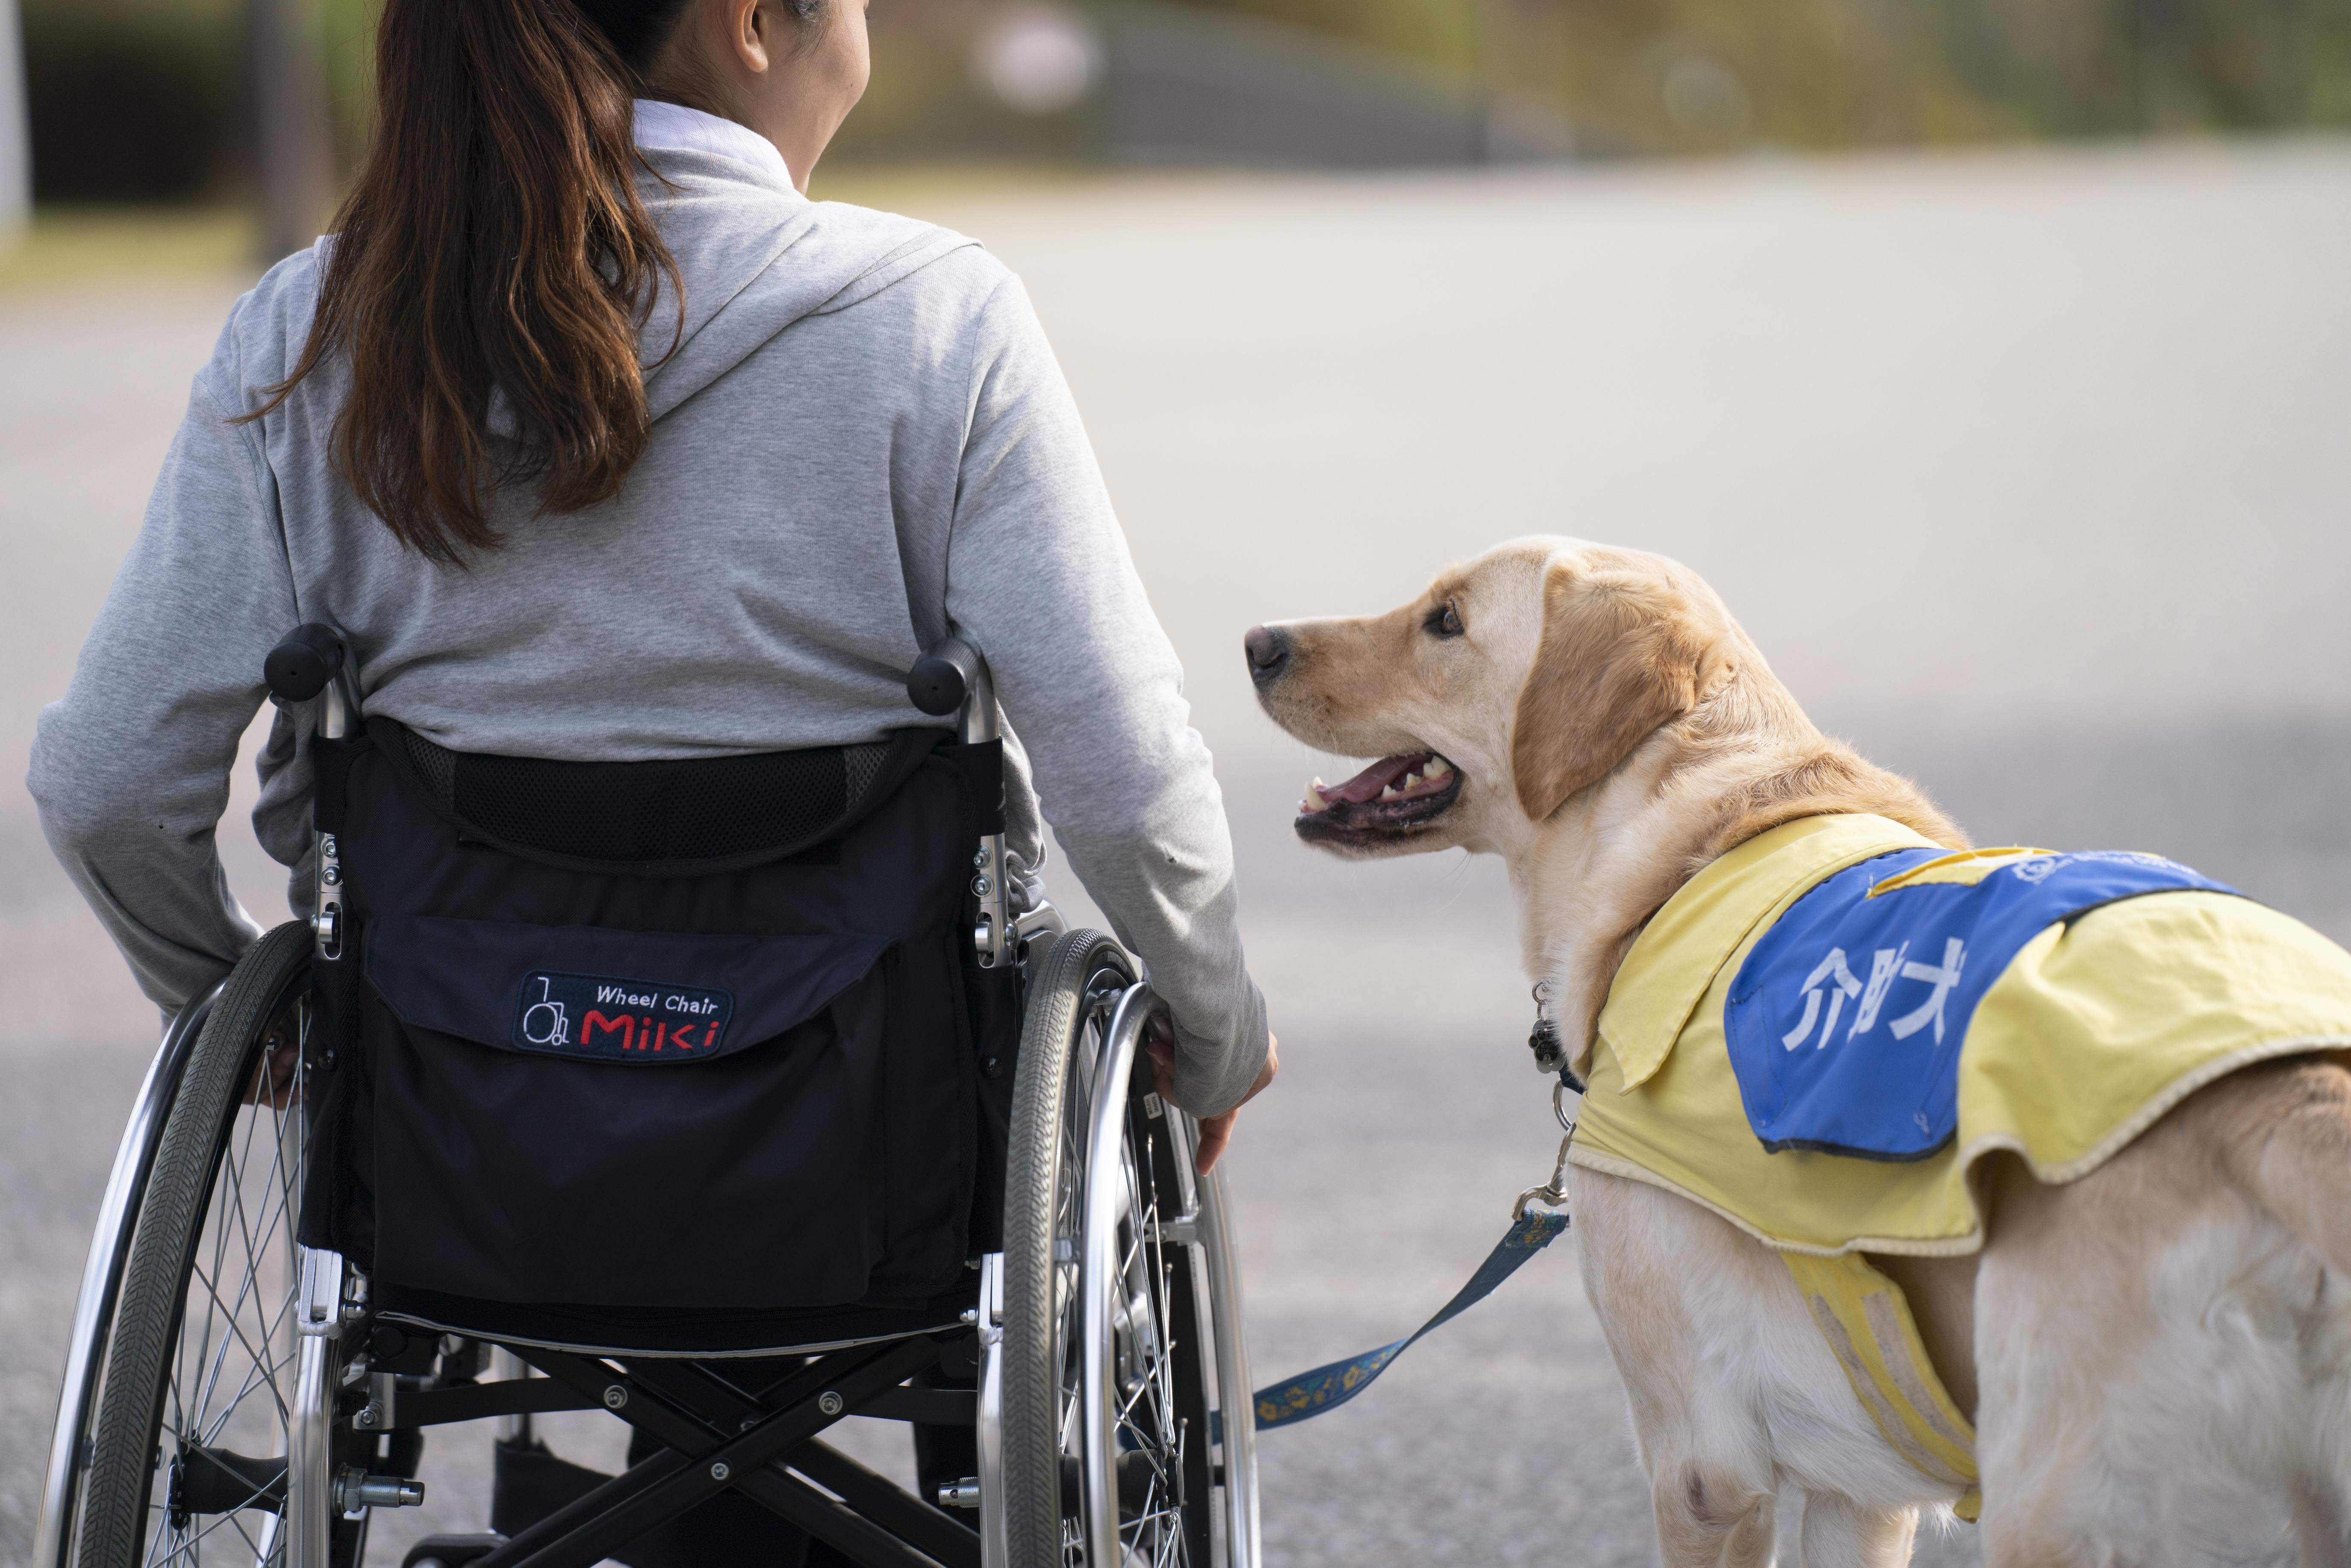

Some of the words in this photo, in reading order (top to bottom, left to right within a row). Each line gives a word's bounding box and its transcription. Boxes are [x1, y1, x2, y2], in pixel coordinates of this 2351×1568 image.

[597, 986, 658, 1009] Wheel
[665, 995, 719, 1015] Chair
[1782, 936, 1968, 1051] 介助犬
